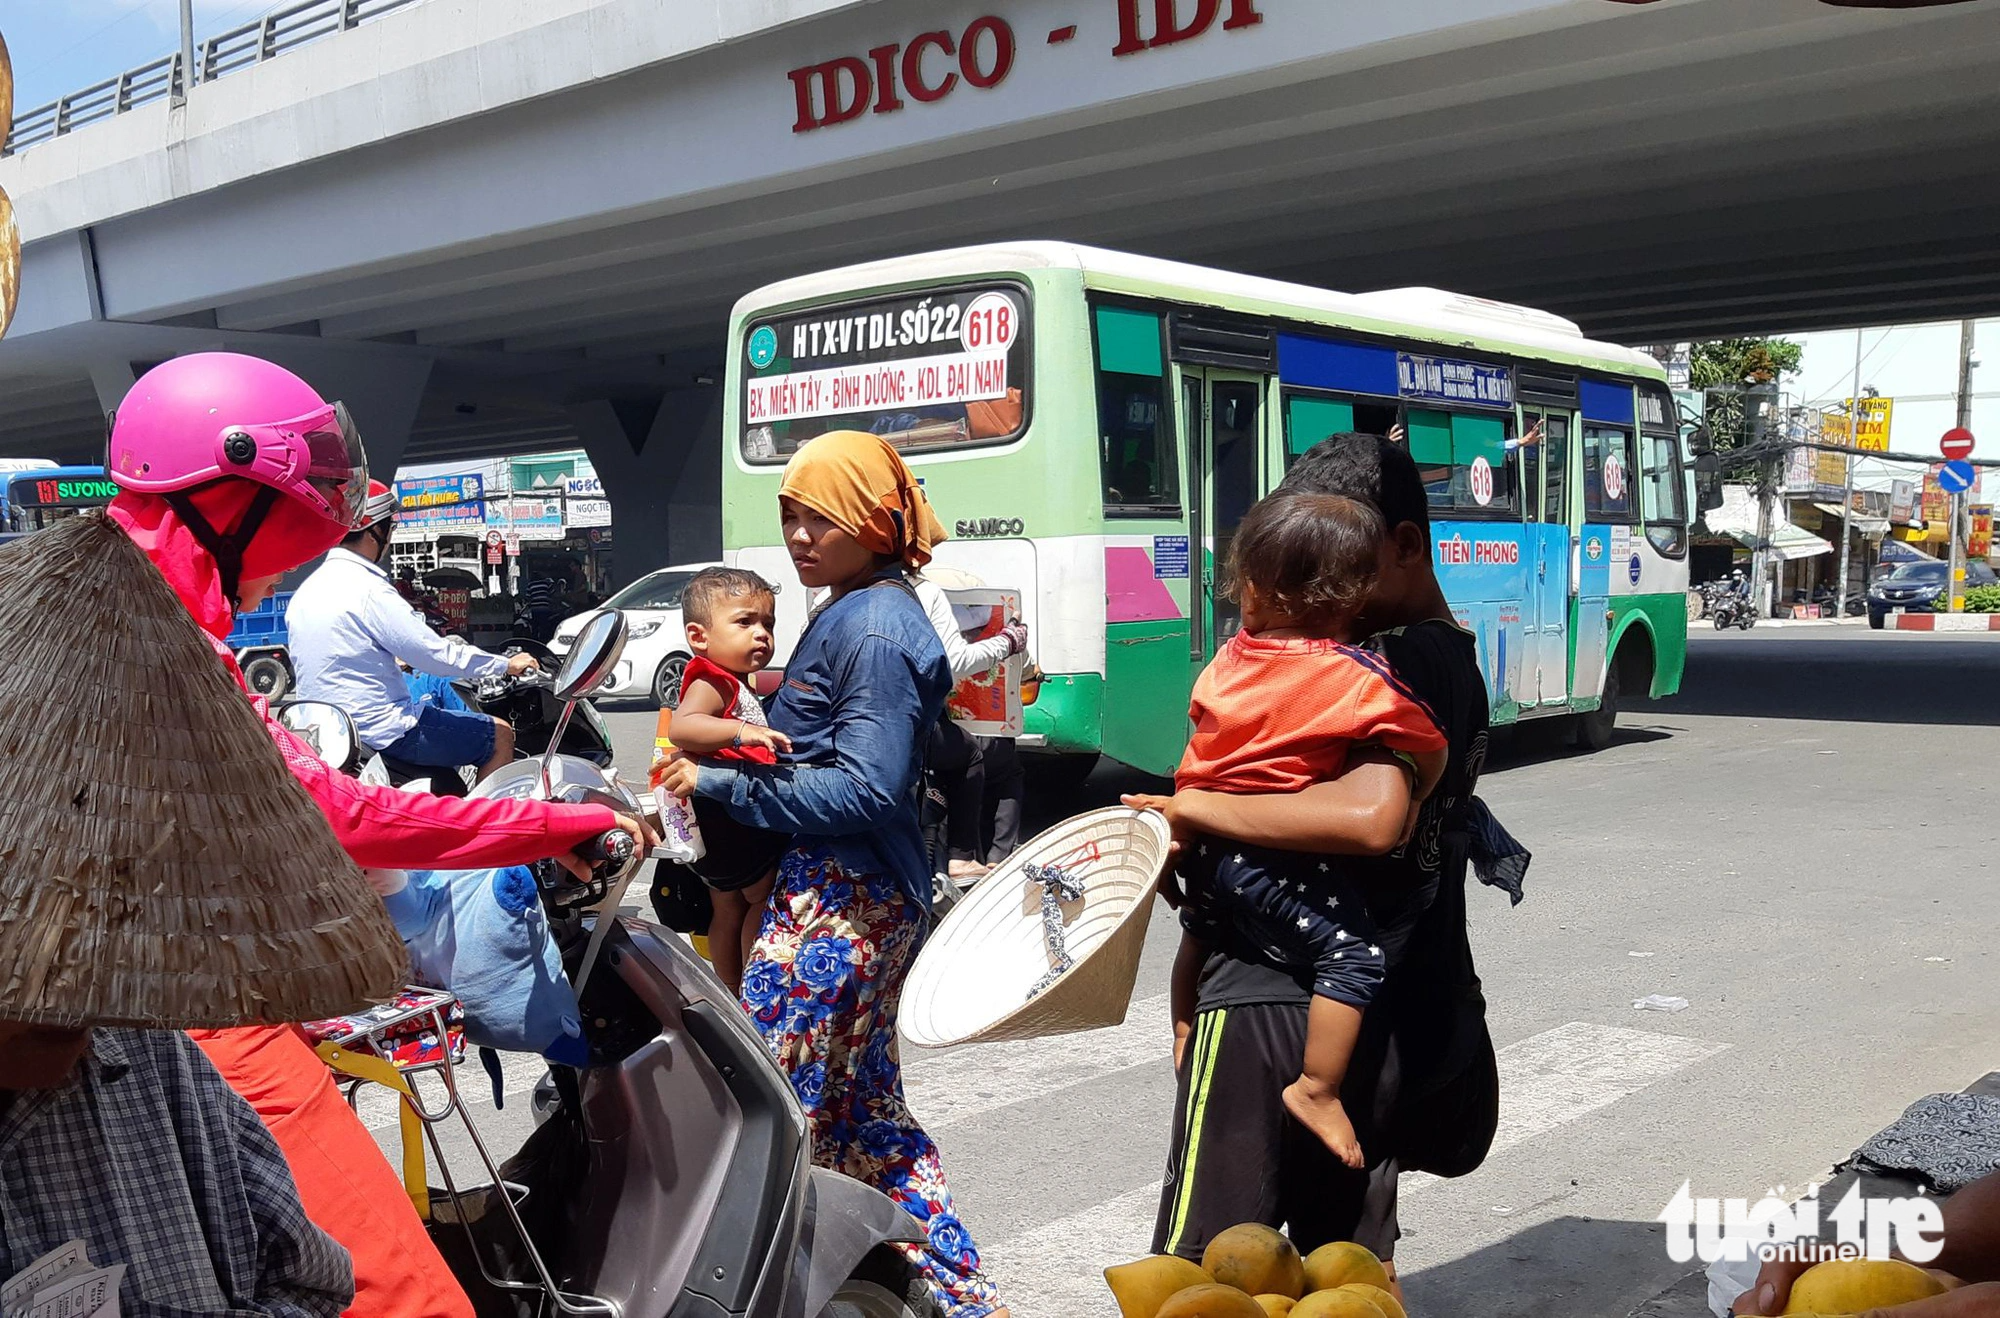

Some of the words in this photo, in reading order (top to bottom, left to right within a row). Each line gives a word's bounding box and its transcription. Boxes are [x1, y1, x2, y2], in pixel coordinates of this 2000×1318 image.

[788, 15, 1016, 133] IDICO
[969, 306, 1010, 347] 618
[749, 387, 767, 418] BX.
[770, 375, 797, 415] MIỀN
[800, 375, 821, 412] TÂY
[833, 371, 860, 409] BÌNH
[864, 366, 905, 406] DƯƠNG
[918, 366, 942, 400] KDL
[947, 362, 969, 402] ĐẠI
[974, 359, 1004, 394] NAM
[58, 481, 119, 498] SƯƠNG
[1473, 465, 1490, 497] 618
[1606, 462, 1621, 491] 618
[955, 516, 1024, 538] SAMCO
[1438, 533, 1470, 564] TIỀN
[1475, 540, 1519, 564] PHONG
